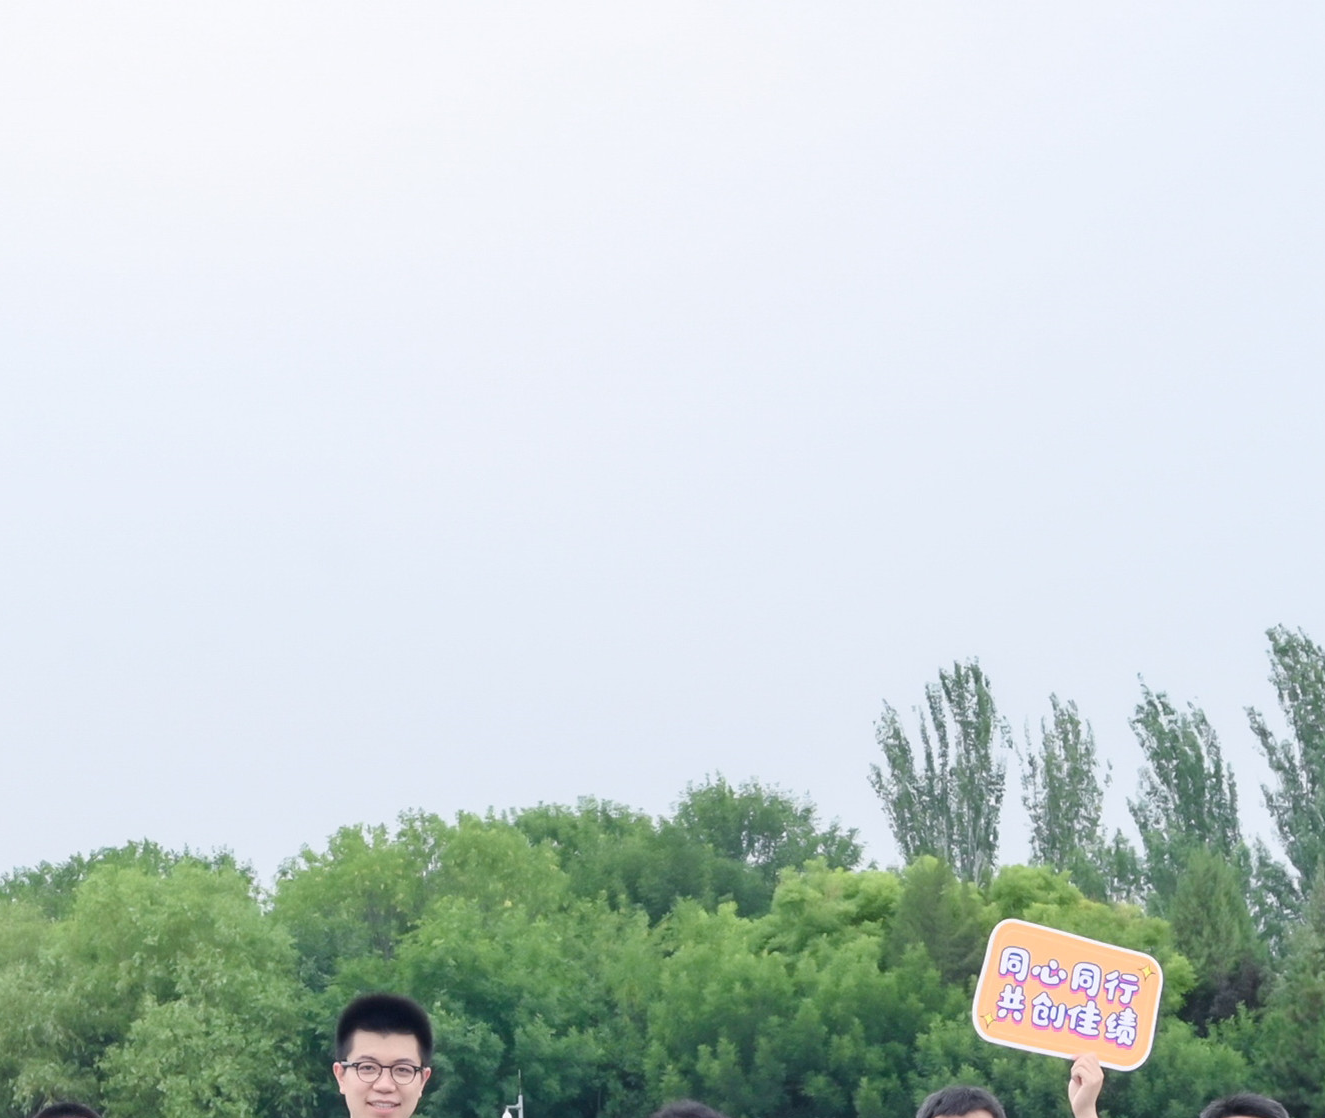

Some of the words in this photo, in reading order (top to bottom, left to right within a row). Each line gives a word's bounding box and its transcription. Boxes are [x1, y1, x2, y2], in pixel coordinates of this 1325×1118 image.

[998, 946, 1139, 1005] 同心同行
[996, 984, 1138, 1048] 共创佳绩
